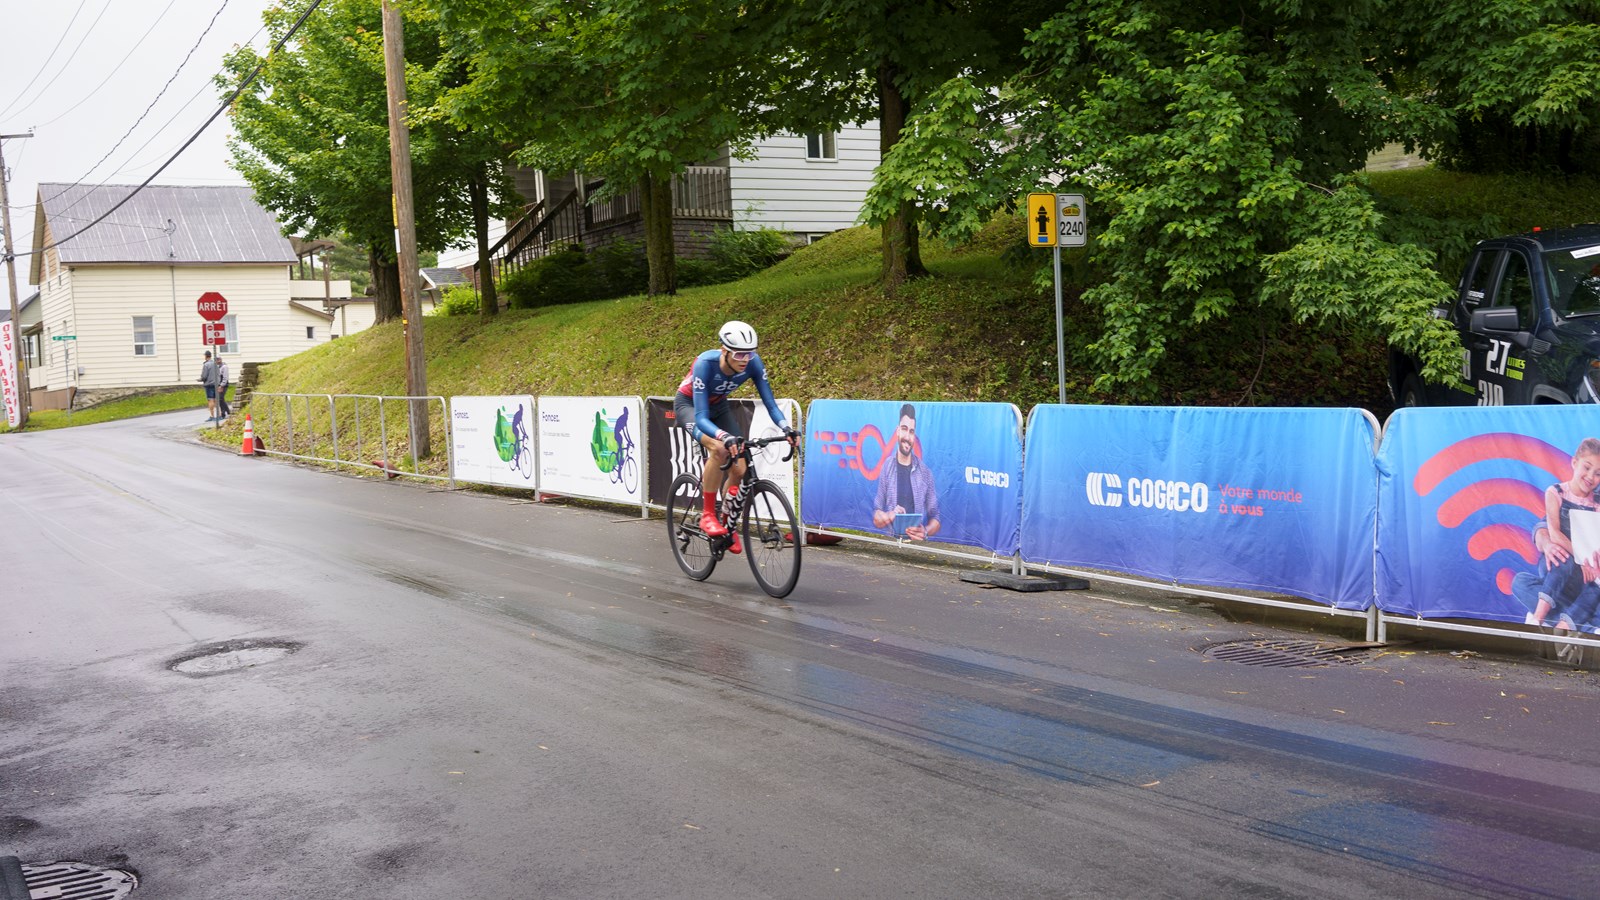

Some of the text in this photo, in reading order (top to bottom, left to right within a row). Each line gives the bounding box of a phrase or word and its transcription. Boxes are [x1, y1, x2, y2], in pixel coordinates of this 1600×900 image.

[1060, 221, 1084, 236] 2240
[198, 300, 227, 312] ARRÊT
[1218, 483, 1303, 504] Votre monde
[1219, 499, 1264, 517] à vous
